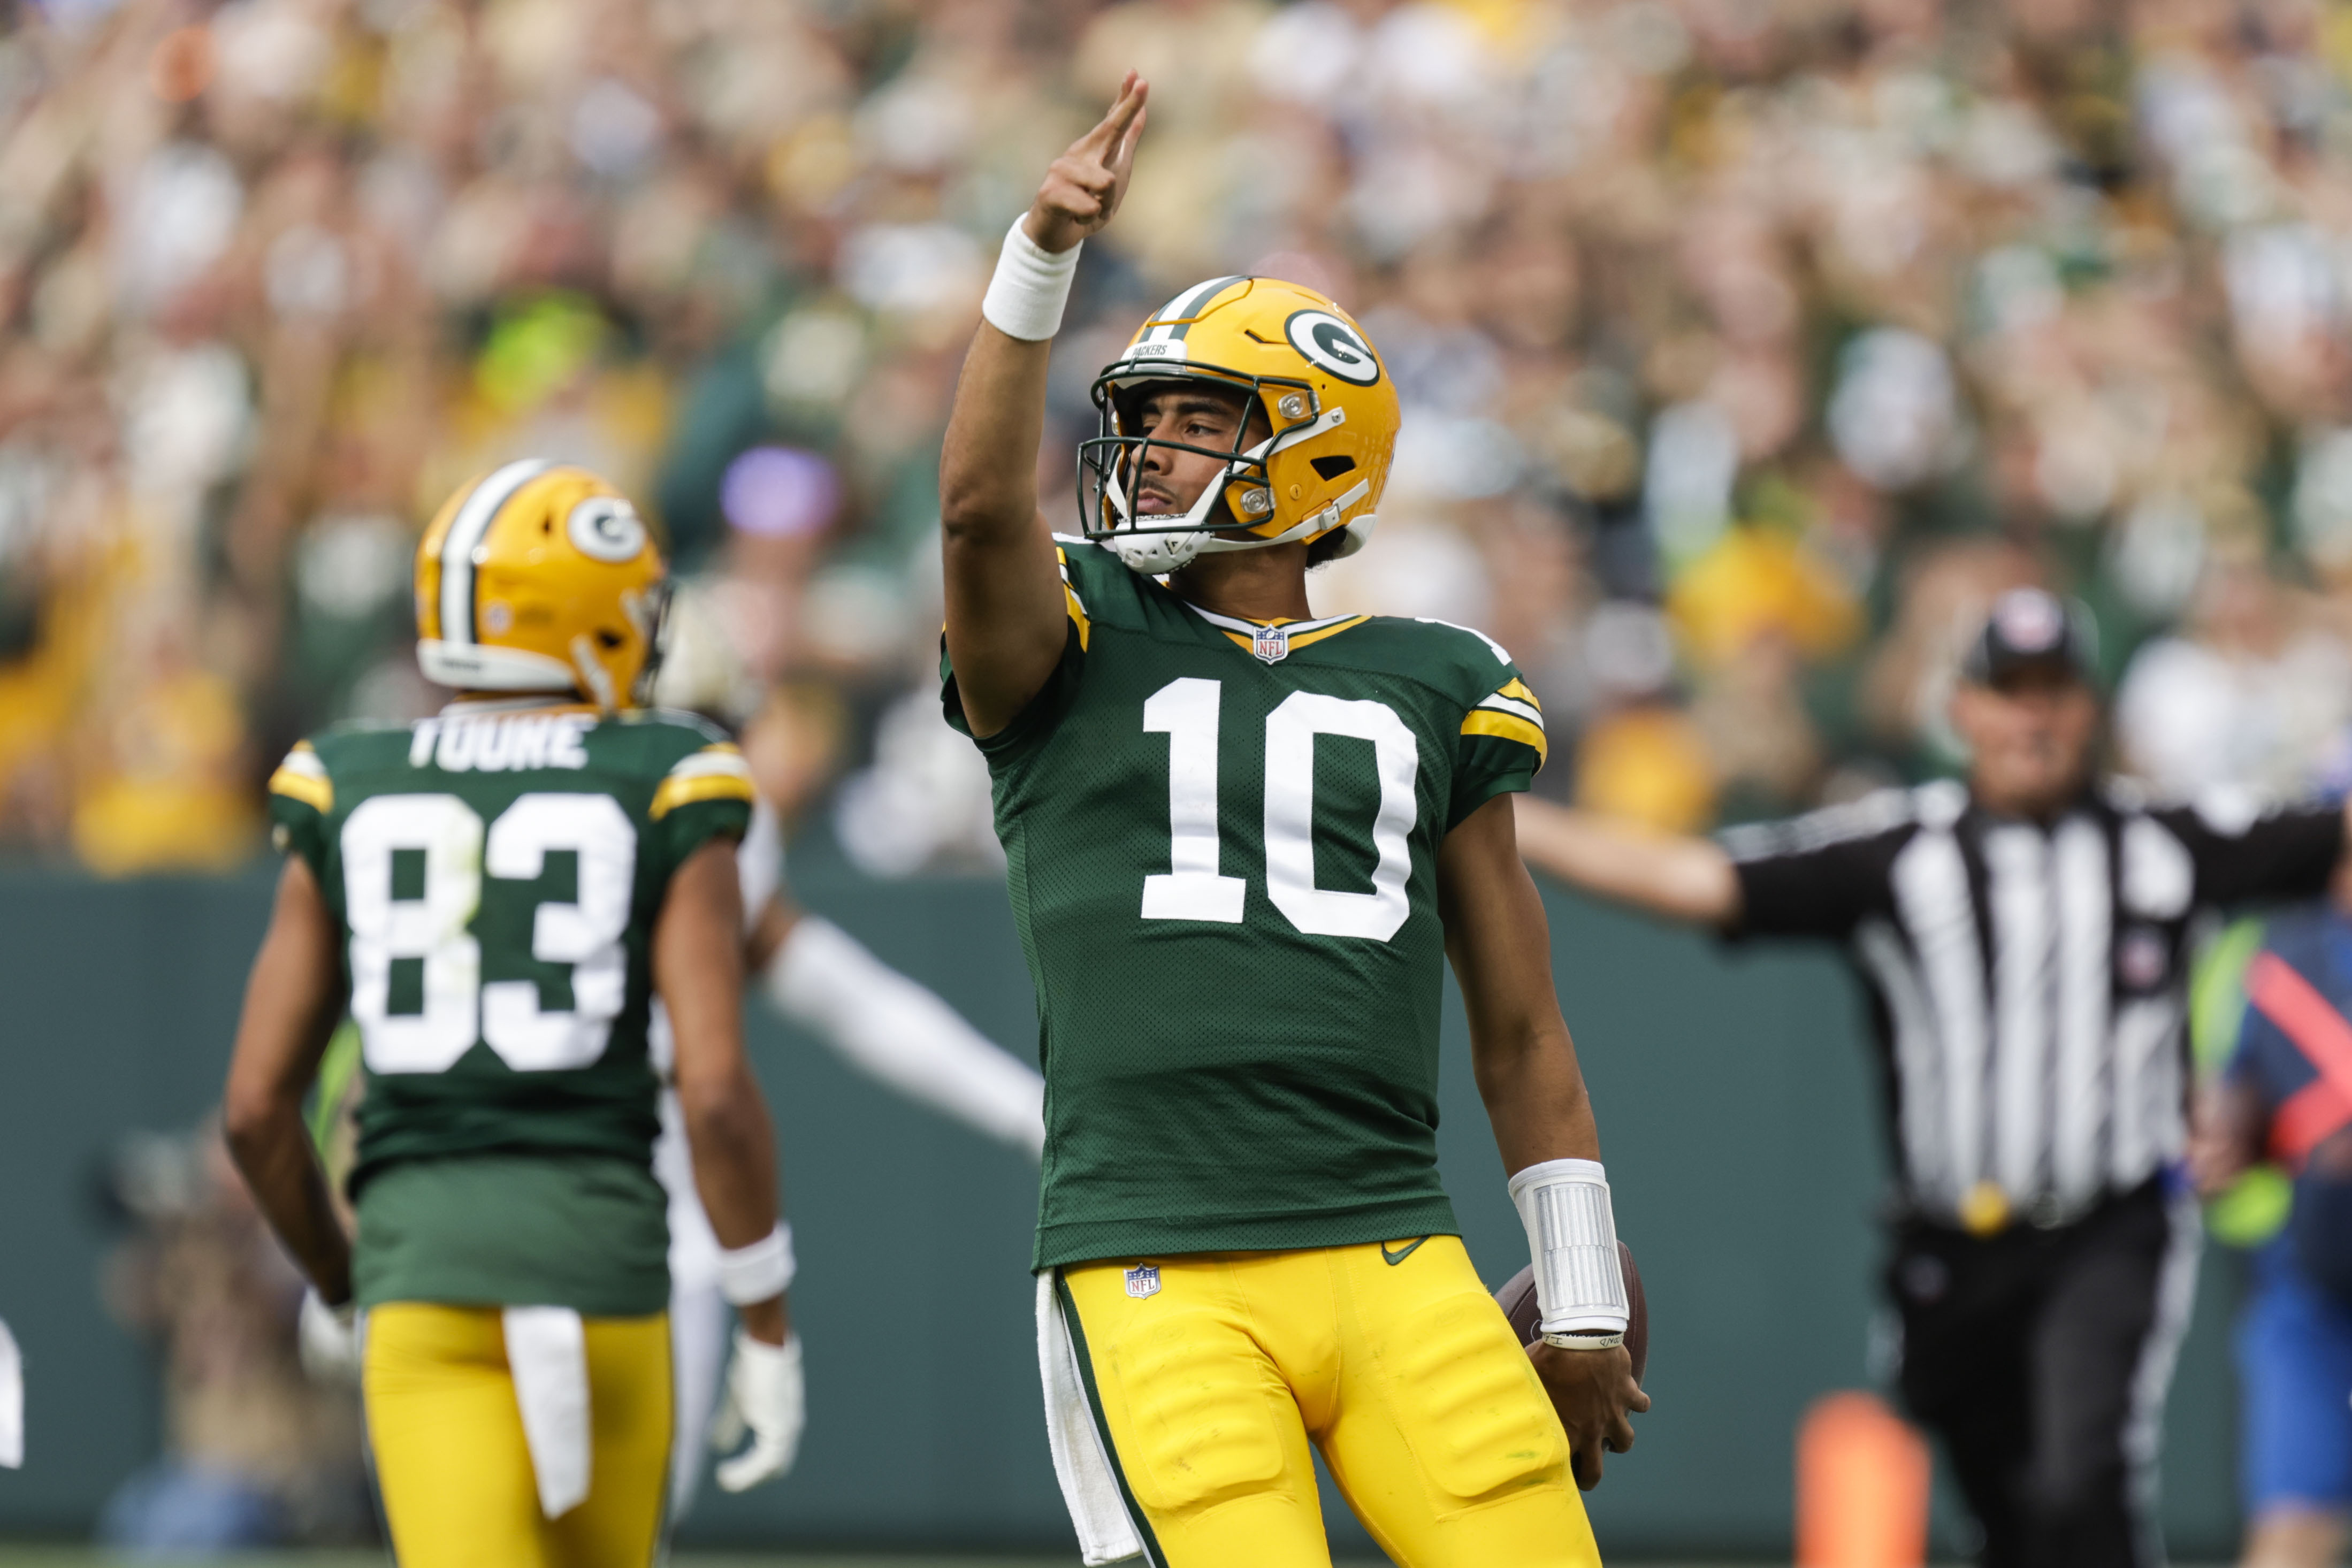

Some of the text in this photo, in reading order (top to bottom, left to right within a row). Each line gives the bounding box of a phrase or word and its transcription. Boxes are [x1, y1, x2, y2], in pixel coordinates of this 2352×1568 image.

[1133, 344, 1167, 357] PACKERS
[1287, 310, 1379, 384] G
[1259, 641, 1282, 657] NFL
[1141, 677, 1419, 942] 10
[340, 792, 637, 1074] 83
[1131, 1279, 1155, 1292] NFL
